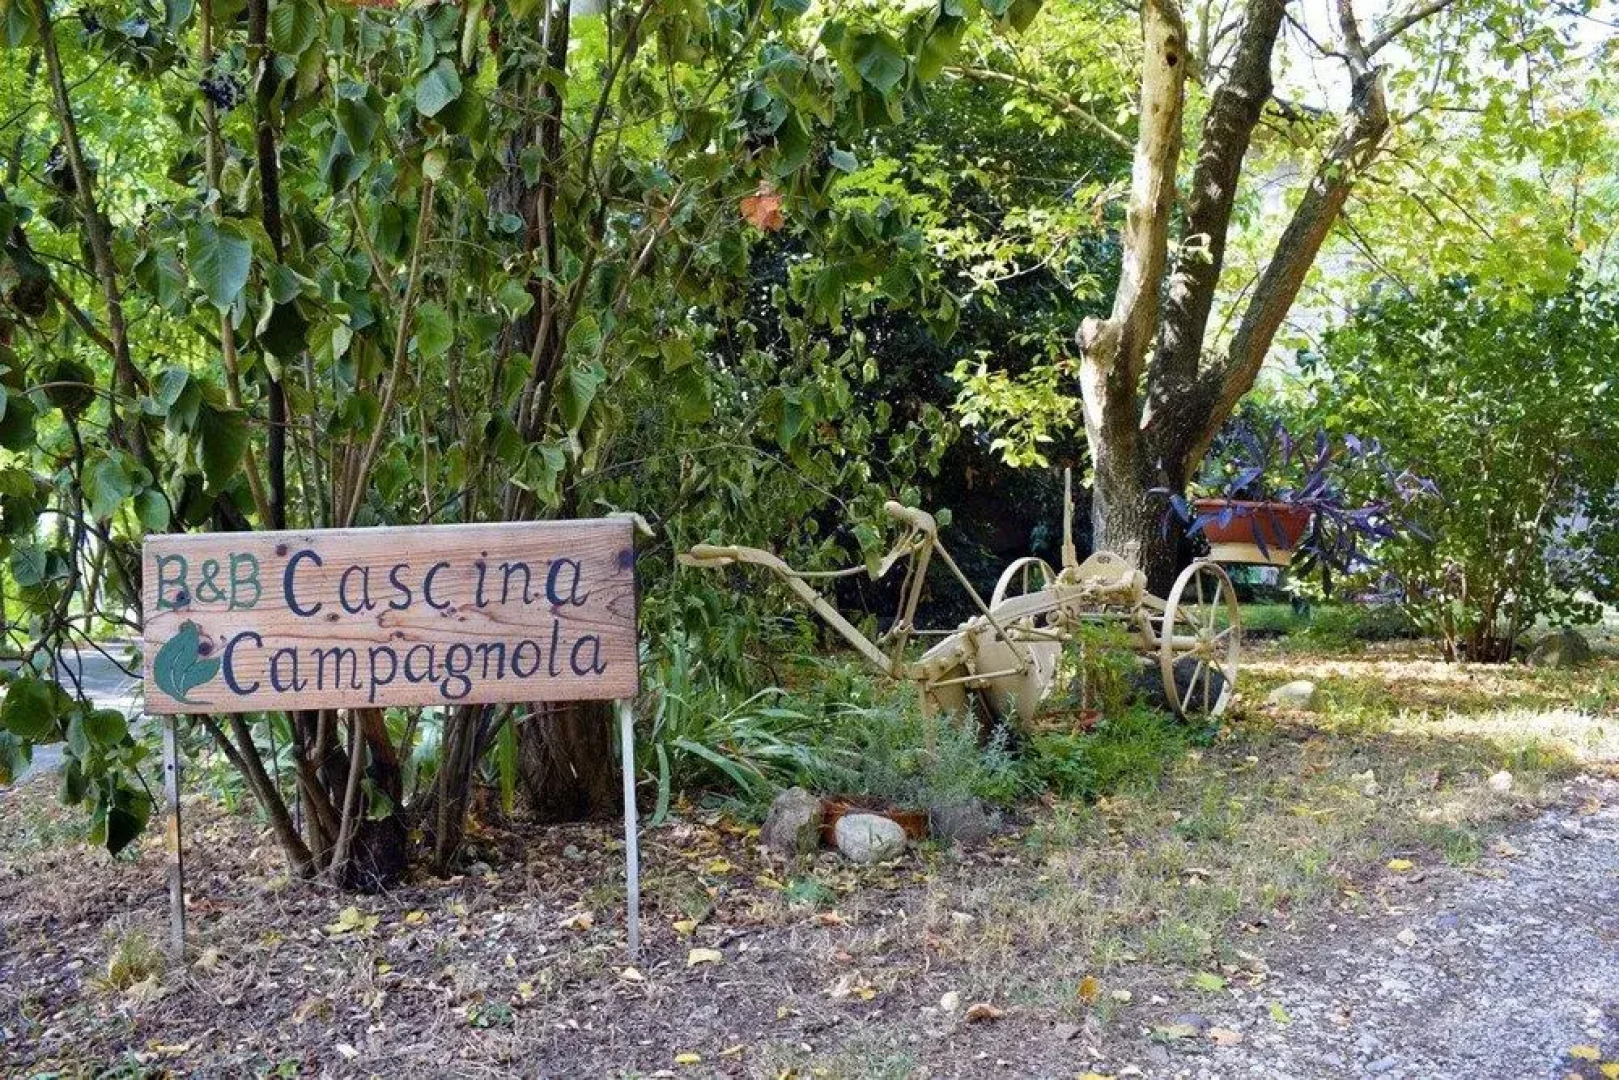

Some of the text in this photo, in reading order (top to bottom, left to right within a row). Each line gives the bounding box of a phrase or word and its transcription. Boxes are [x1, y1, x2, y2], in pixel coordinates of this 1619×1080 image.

[155, 549, 591, 617] B&B Cascina
[222, 619, 608, 703] Campagnola
